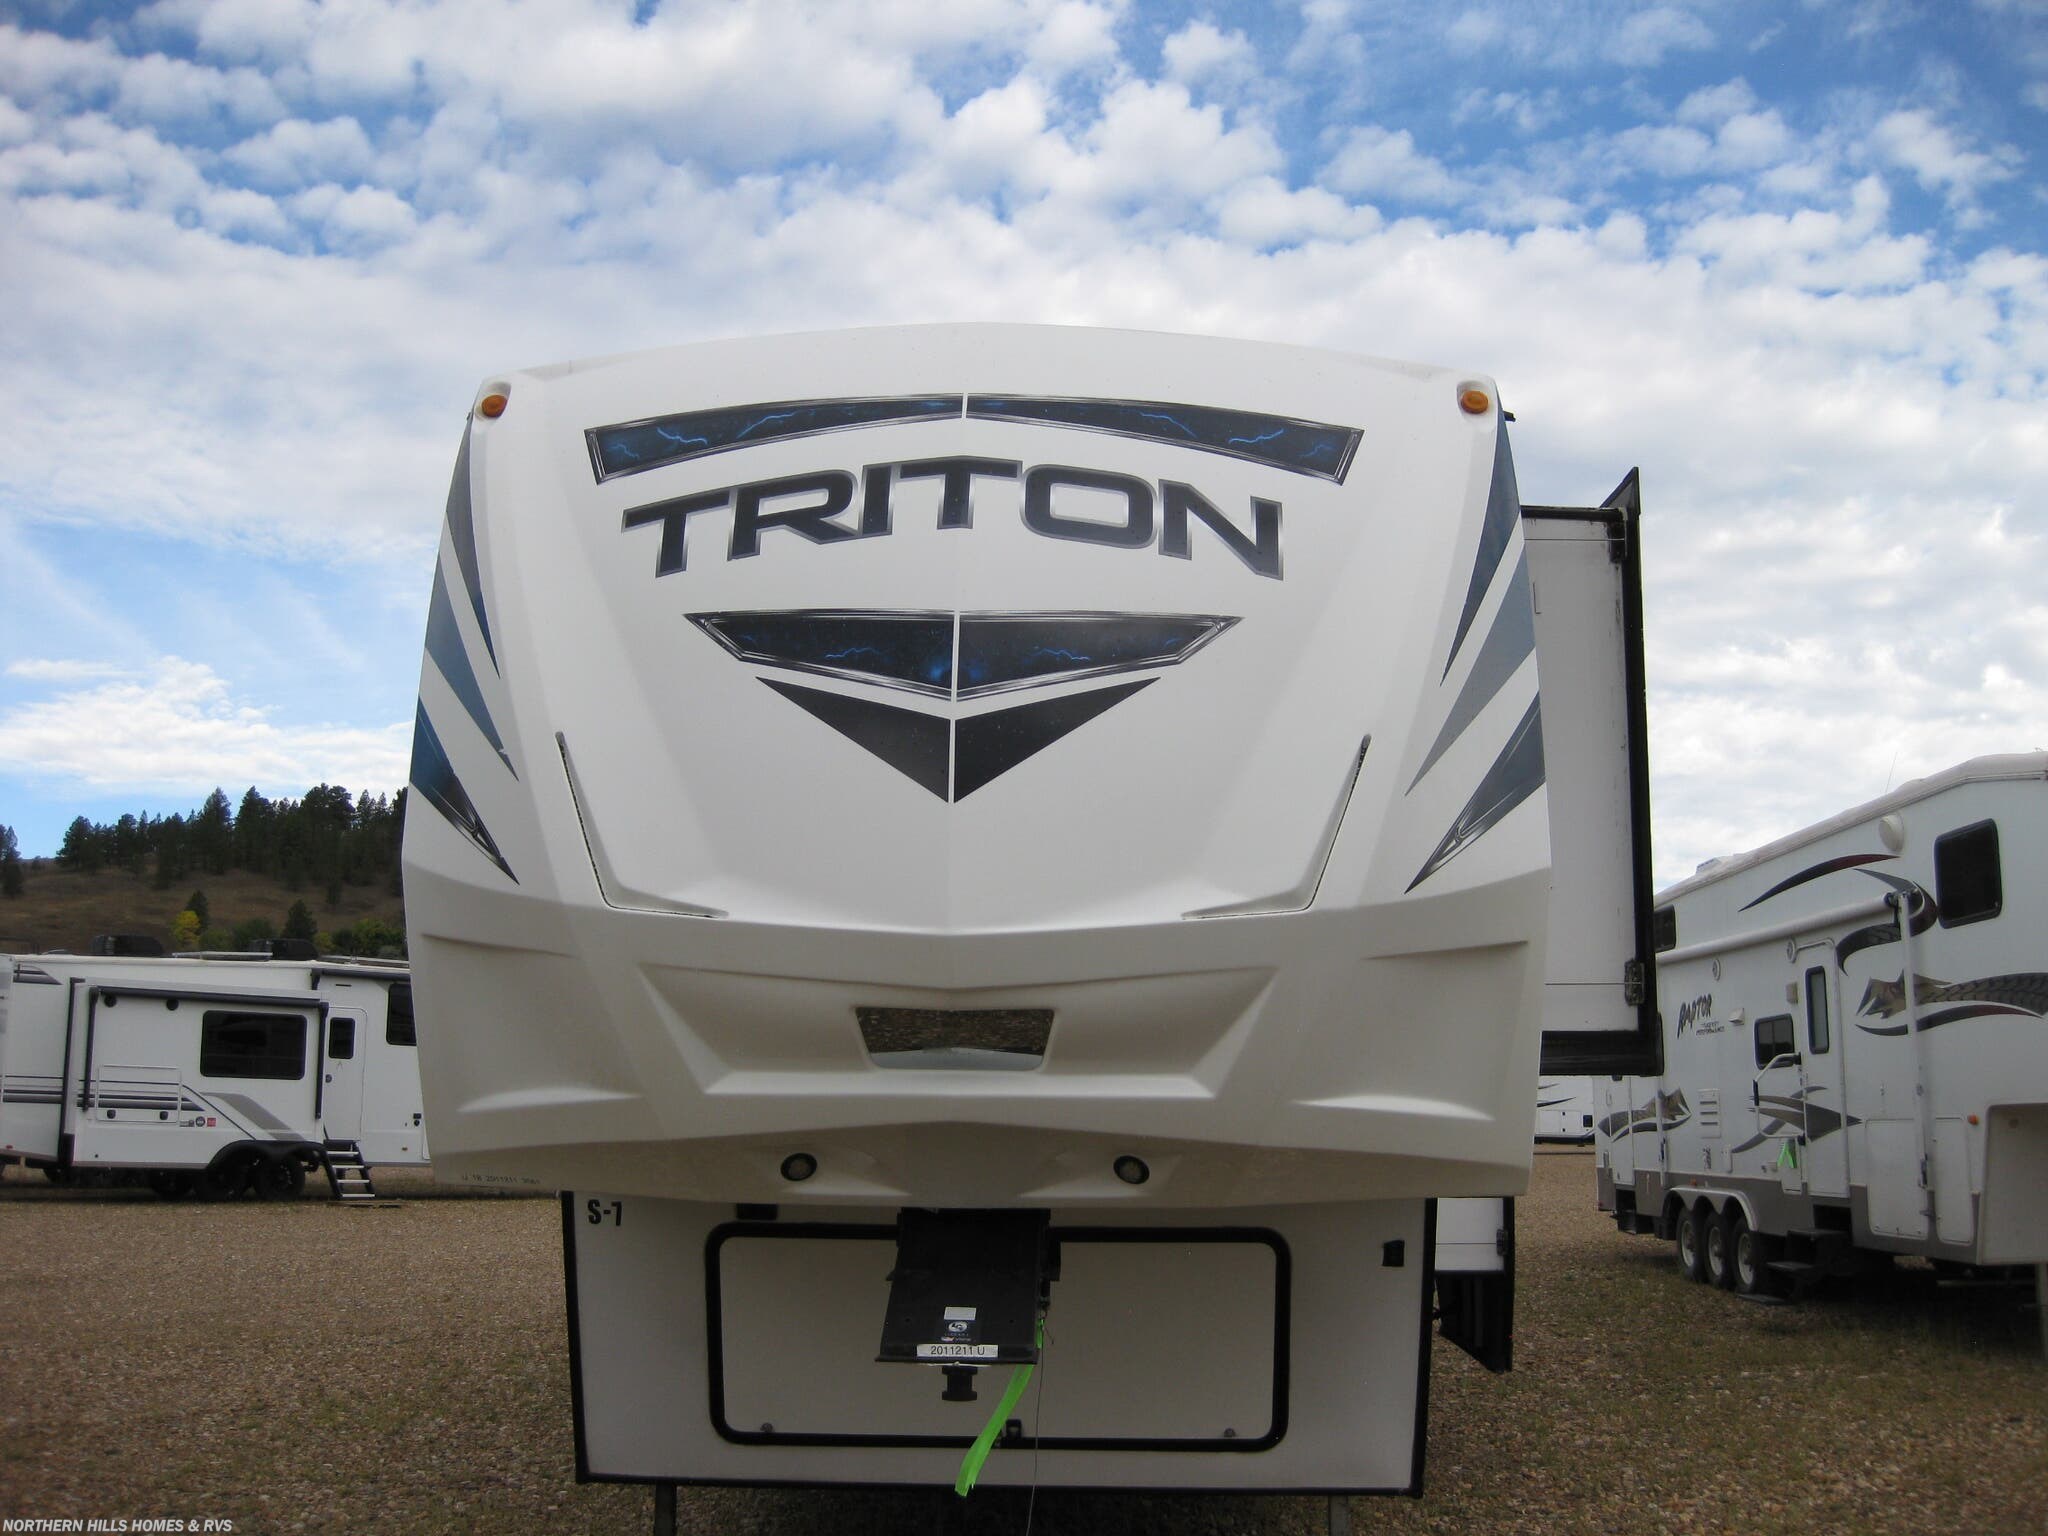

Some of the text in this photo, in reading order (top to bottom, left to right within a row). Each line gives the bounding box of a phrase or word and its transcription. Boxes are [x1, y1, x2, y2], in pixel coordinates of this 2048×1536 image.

[621, 455, 1283, 580] TRITON
[1677, 993, 1712, 1039] RAPTOR
[587, 1199, 622, 1226] S-7
[930, 1345, 985, 1355] 2011211 U
